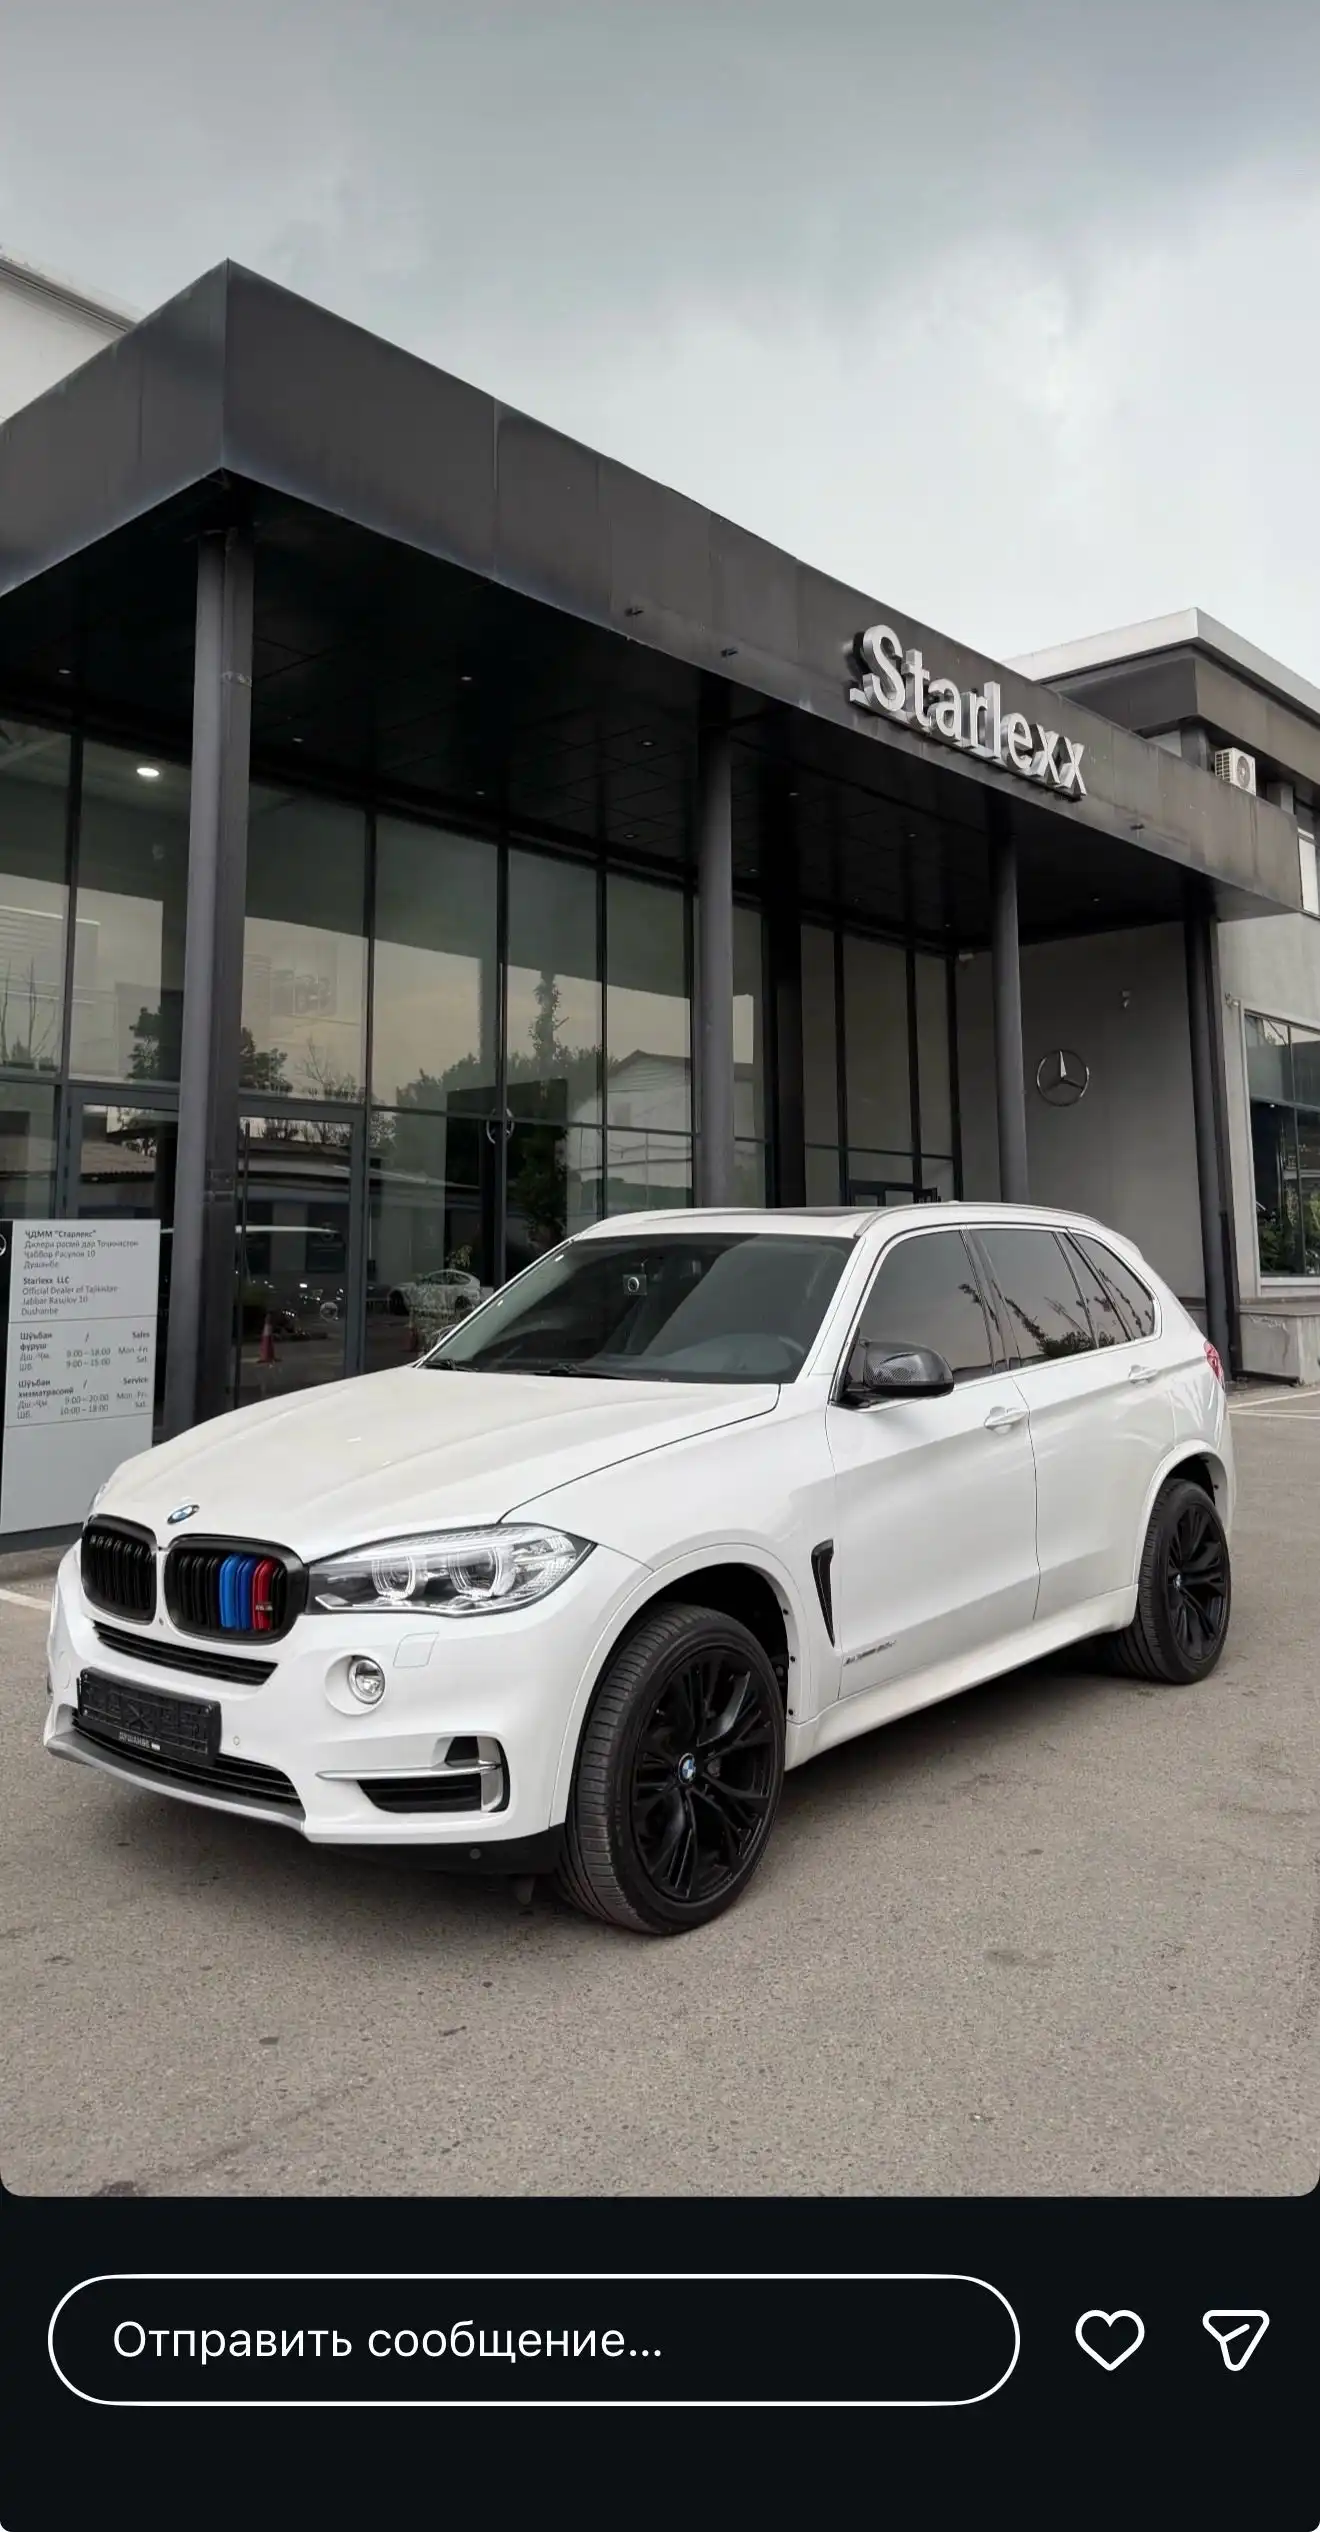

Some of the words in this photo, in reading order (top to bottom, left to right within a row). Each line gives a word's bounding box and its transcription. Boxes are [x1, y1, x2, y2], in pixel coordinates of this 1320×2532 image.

[858, 624, 1088, 797] Starlexx
[23, 1276, 53, 1285] Starlexx
[57, 1275, 71, 1284] LLC
[22, 1286, 49, 1295] Official
[50, 1286, 74, 1295] Dealer
[76, 1285, 84, 1293] of
[21, 1307, 59, 1316] Dushanbe
[131, 1331, 150, 1339] Sales
[123, 1377, 149, 1385] Service
